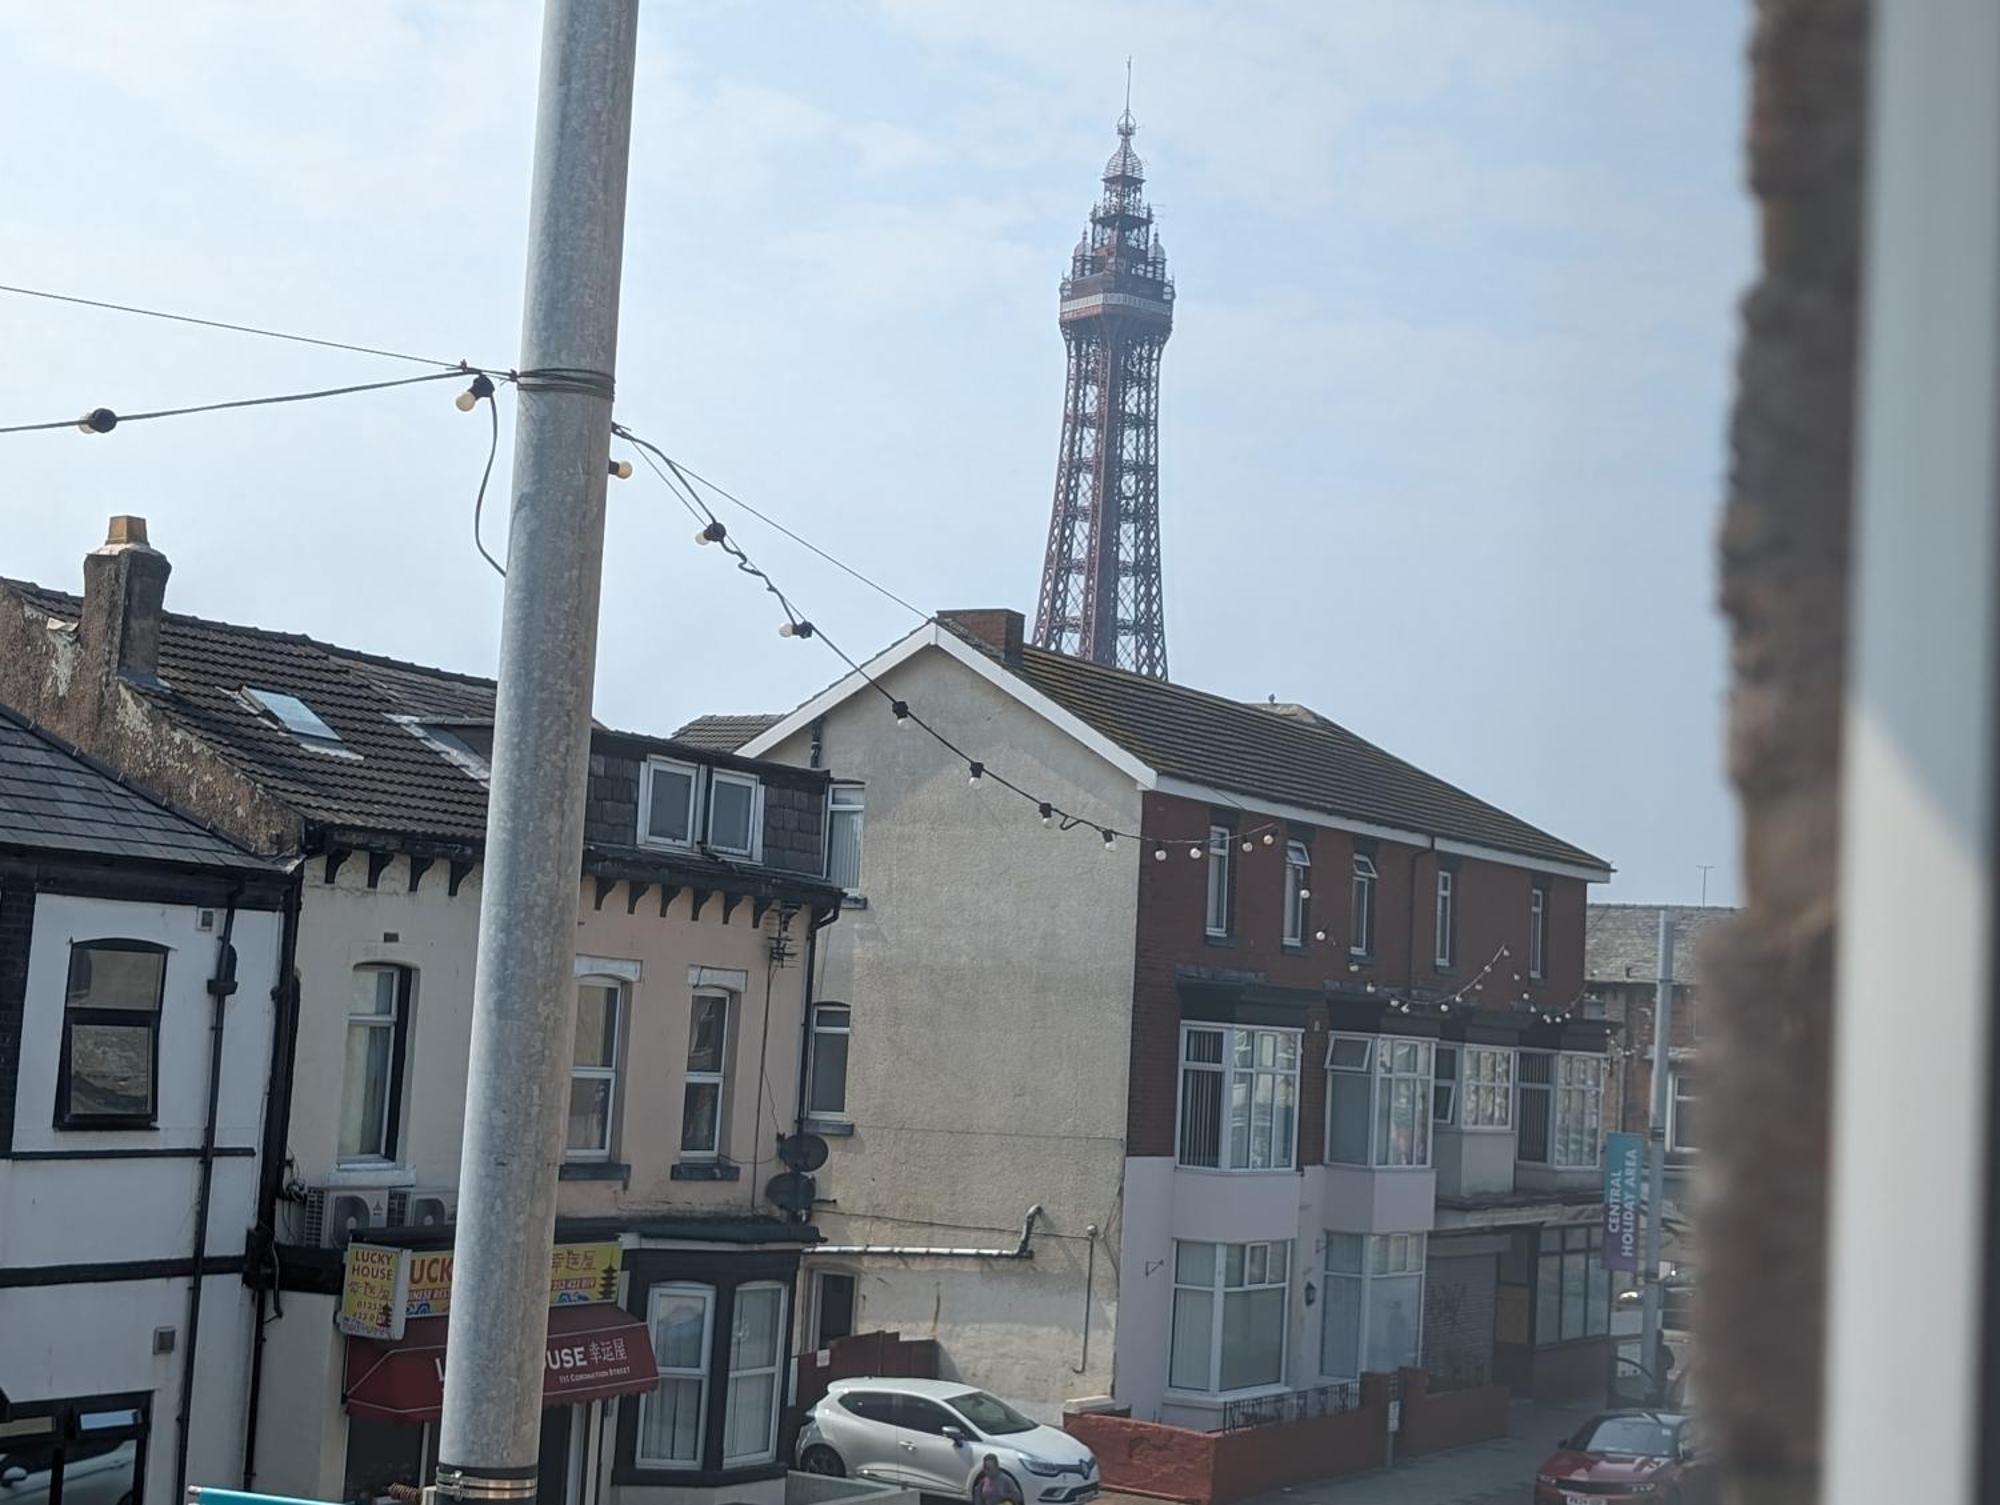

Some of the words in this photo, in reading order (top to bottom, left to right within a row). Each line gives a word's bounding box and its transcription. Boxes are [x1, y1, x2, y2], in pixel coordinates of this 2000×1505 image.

[1624, 1149, 1638, 1187] AREA
[1608, 1170, 1623, 1233] CENTRAL
[1621, 1192, 1636, 1257] HOLIDAY
[351, 1263, 393, 1281] HOUSE
[355, 1250, 393, 1266] LUCKY
[410, 1257, 454, 1285] UCK
[546, 1347, 587, 1370] USE
